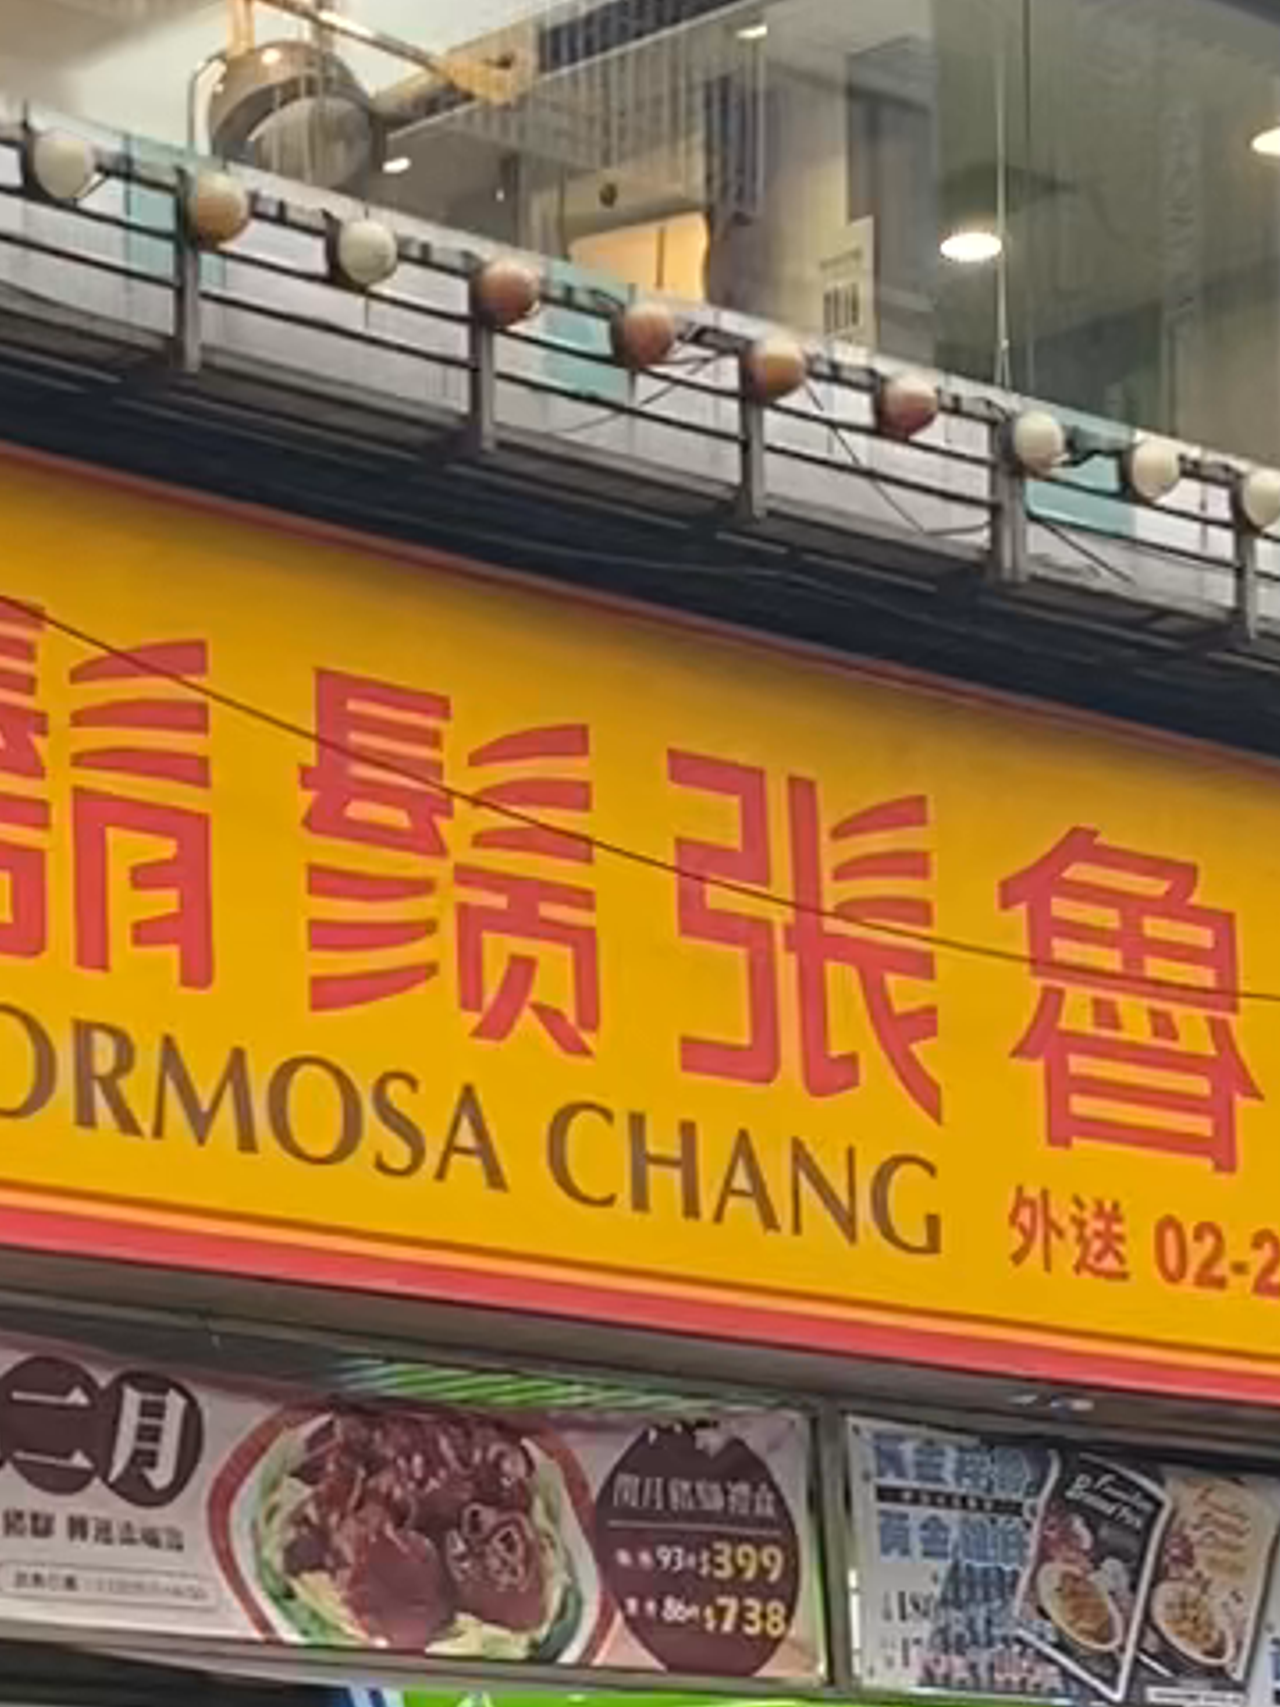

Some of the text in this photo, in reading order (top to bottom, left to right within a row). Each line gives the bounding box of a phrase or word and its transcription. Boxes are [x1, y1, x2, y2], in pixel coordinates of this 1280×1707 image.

[544, 1100, 944, 1257] CHANG
[1007, 1181, 1131, 1283] 外送
[699, 1541, 784, 1583] $399
[704, 1596, 787, 1638] $738
